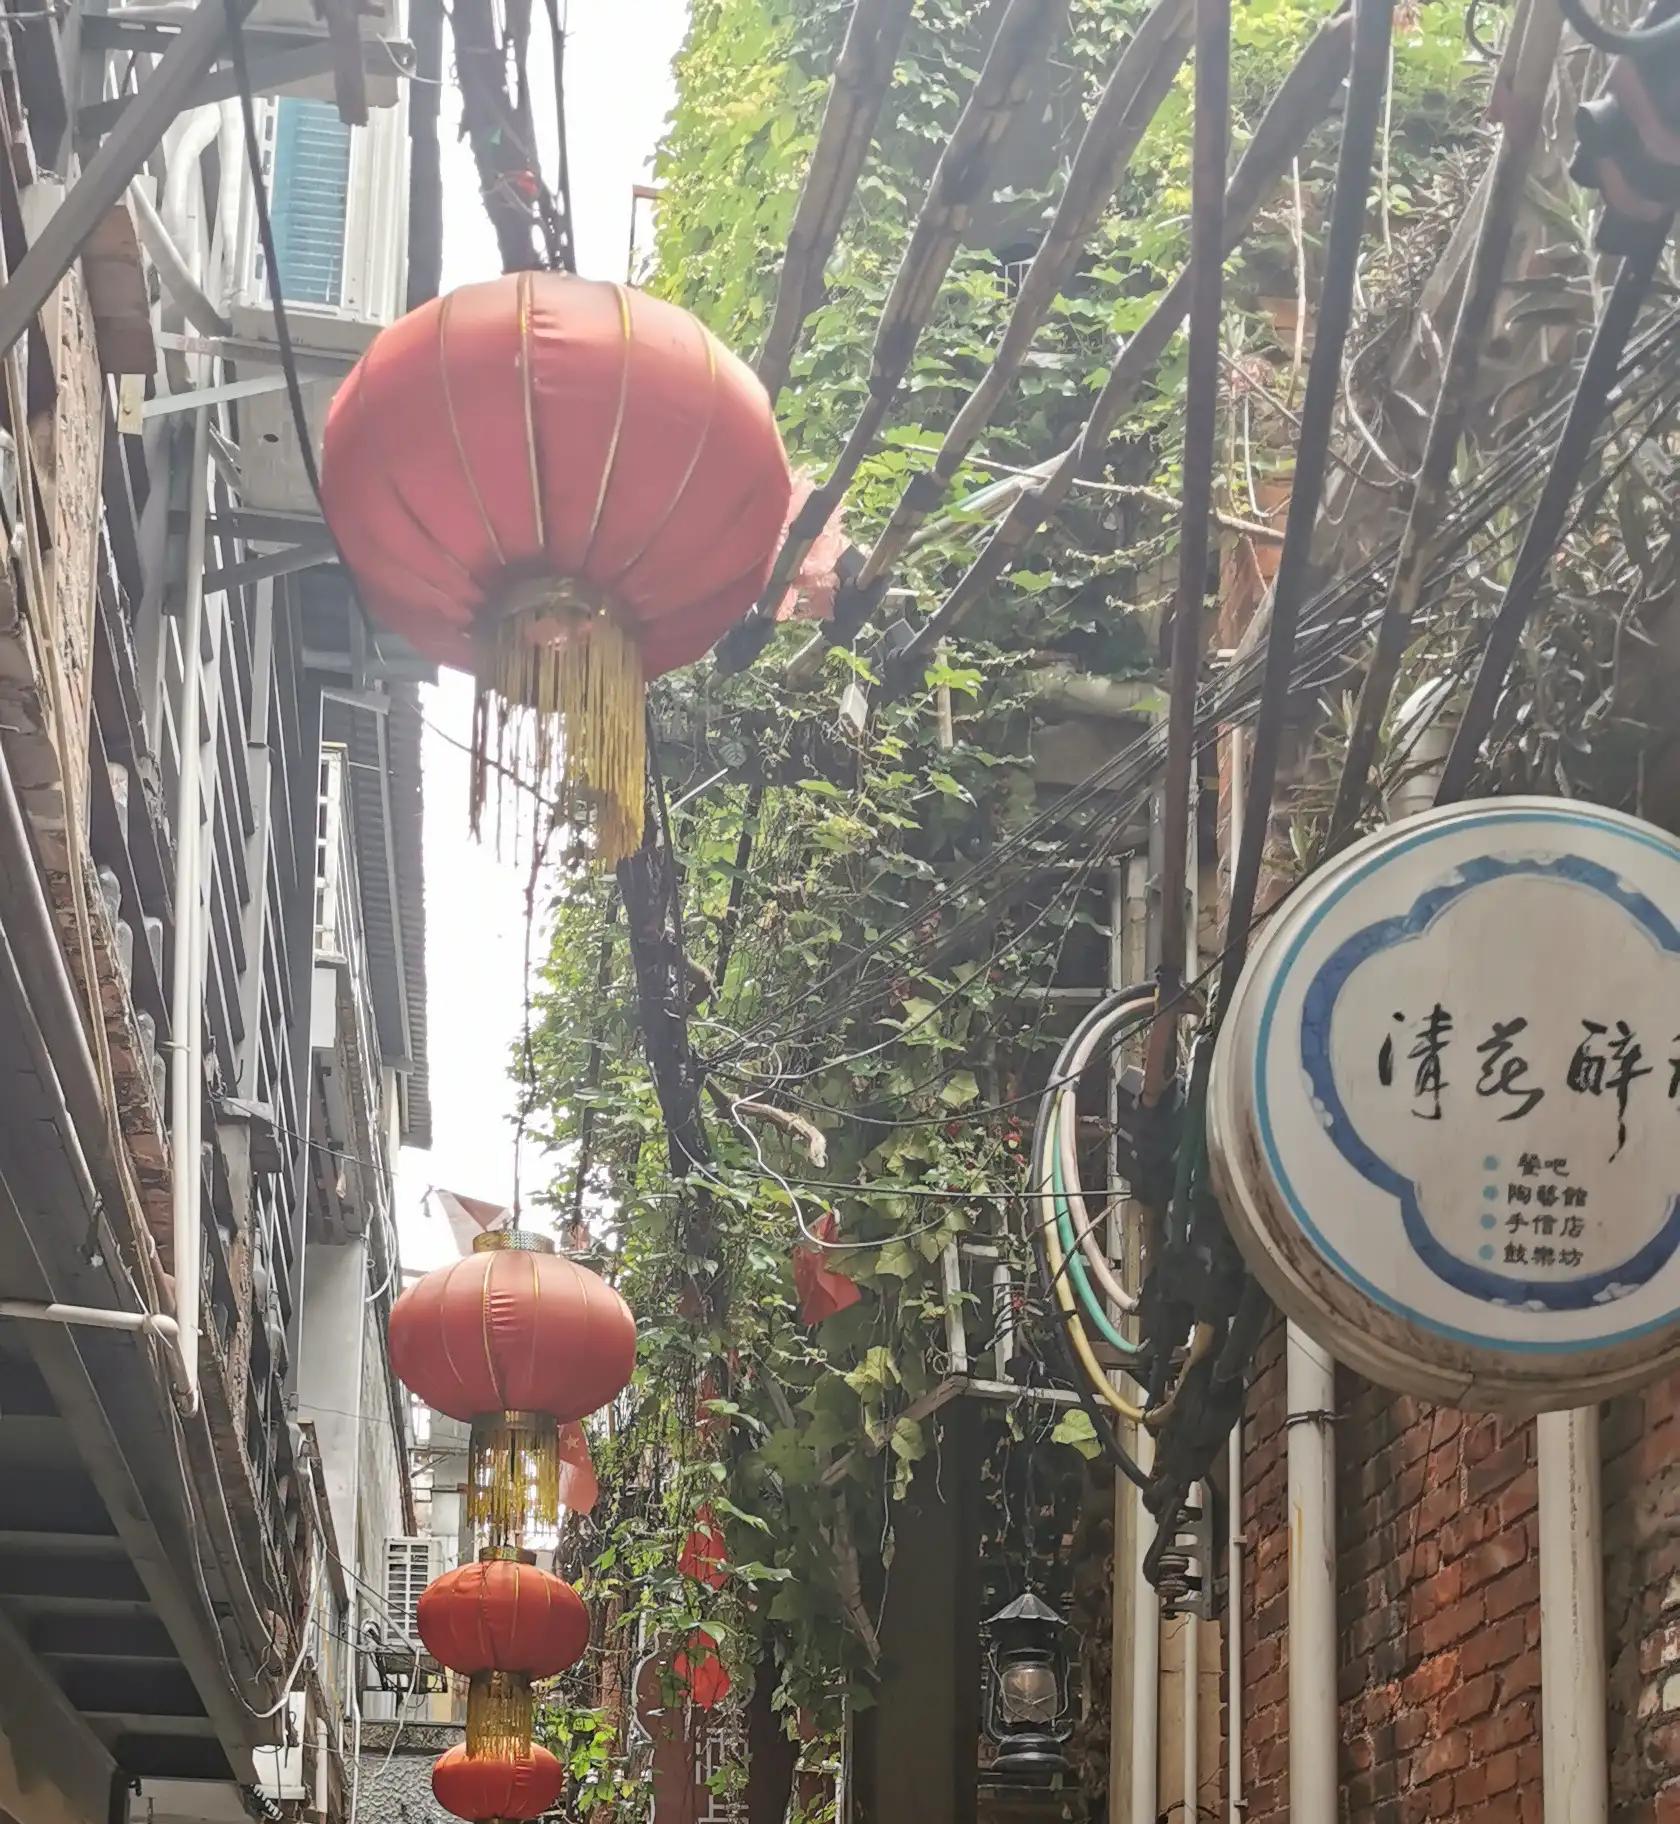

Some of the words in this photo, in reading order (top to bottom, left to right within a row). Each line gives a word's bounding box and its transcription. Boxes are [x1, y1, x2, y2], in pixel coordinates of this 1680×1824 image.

[1378, 1002, 1680, 1164] 清花醉
[1517, 1153, 1570, 1177] 餐吧
[1504, 1212, 1585, 1238] 手信店
